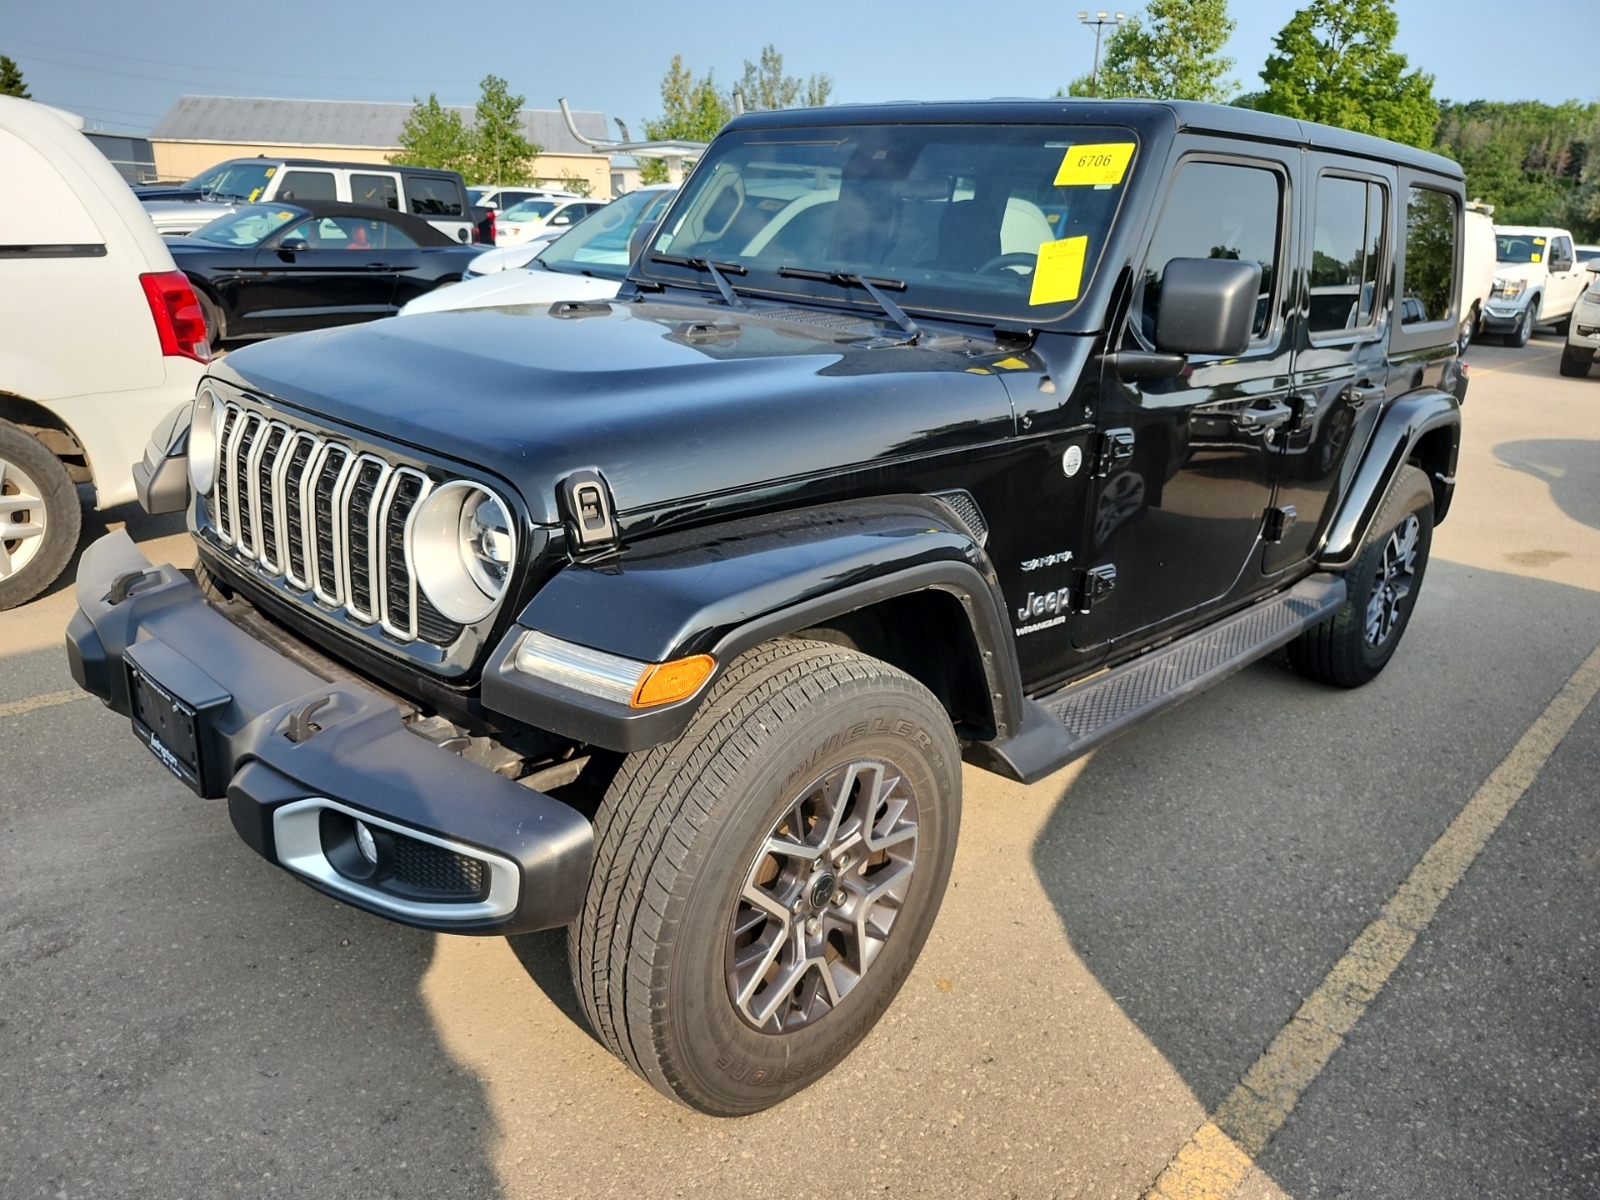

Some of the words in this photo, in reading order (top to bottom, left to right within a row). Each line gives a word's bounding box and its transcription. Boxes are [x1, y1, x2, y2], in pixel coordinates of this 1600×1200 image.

[1077, 154, 1113, 168] 6706
[1020, 550, 1073, 571] SAHARA
[1017, 587, 1070, 621] Jeep
[1015, 615, 1066, 637] WRANGLER
[777, 716, 932, 800] DUELER
